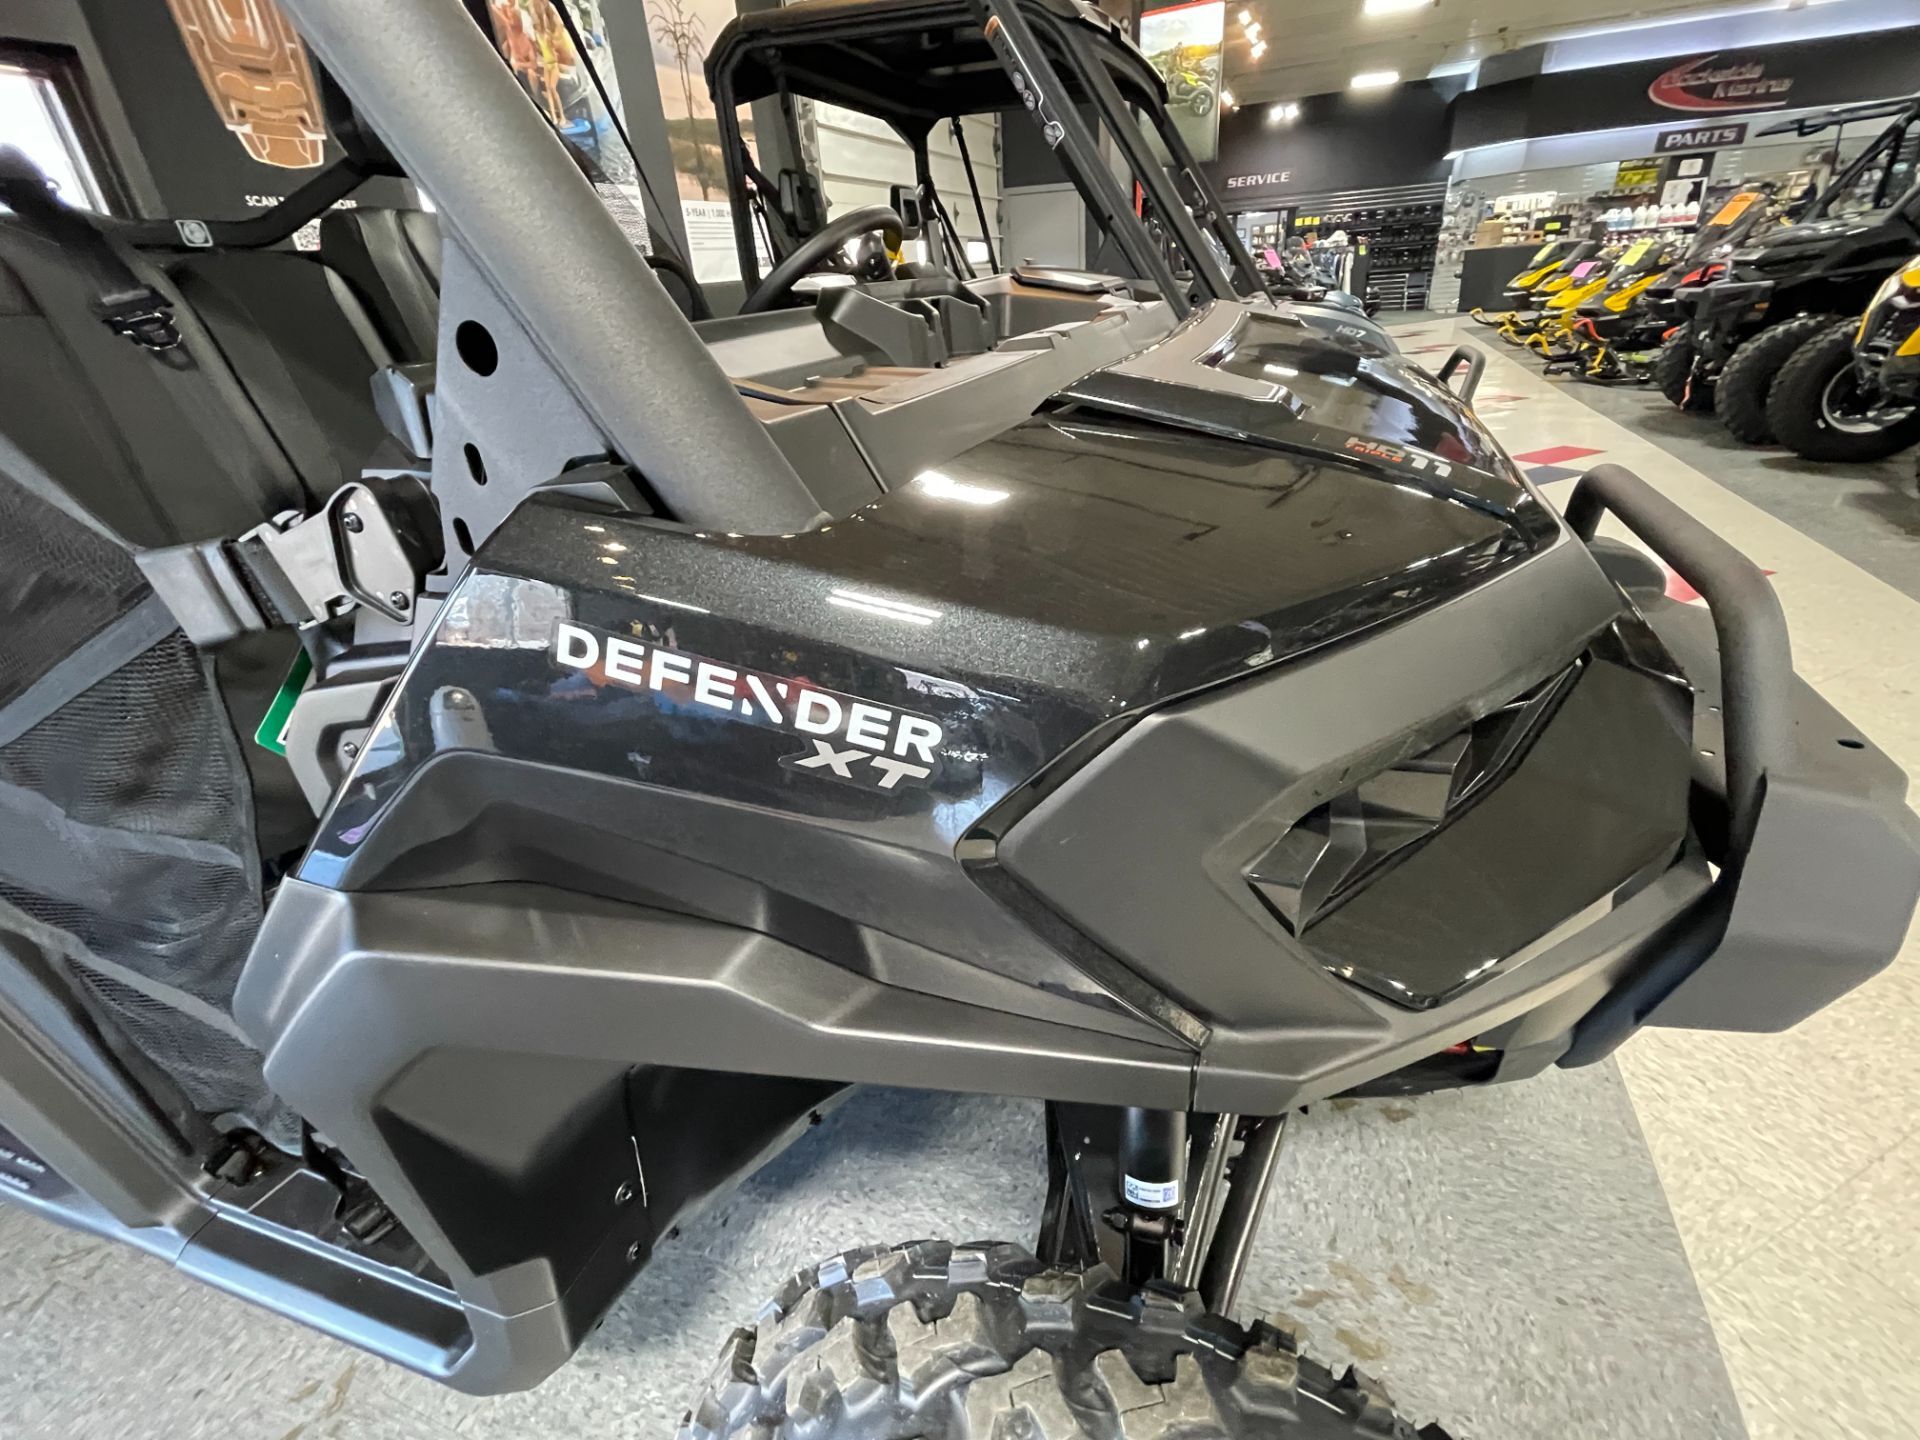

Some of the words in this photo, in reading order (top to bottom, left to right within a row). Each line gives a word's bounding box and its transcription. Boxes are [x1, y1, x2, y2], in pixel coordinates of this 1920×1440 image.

[1664, 127, 1739, 148] PARTS
[1226, 171, 1291, 189] SERVICE
[245, 195, 279, 207] SCAN
[1335, 324, 1367, 338] HD7
[556, 622, 943, 763] DEFENDER
[794, 738, 932, 789] XT
